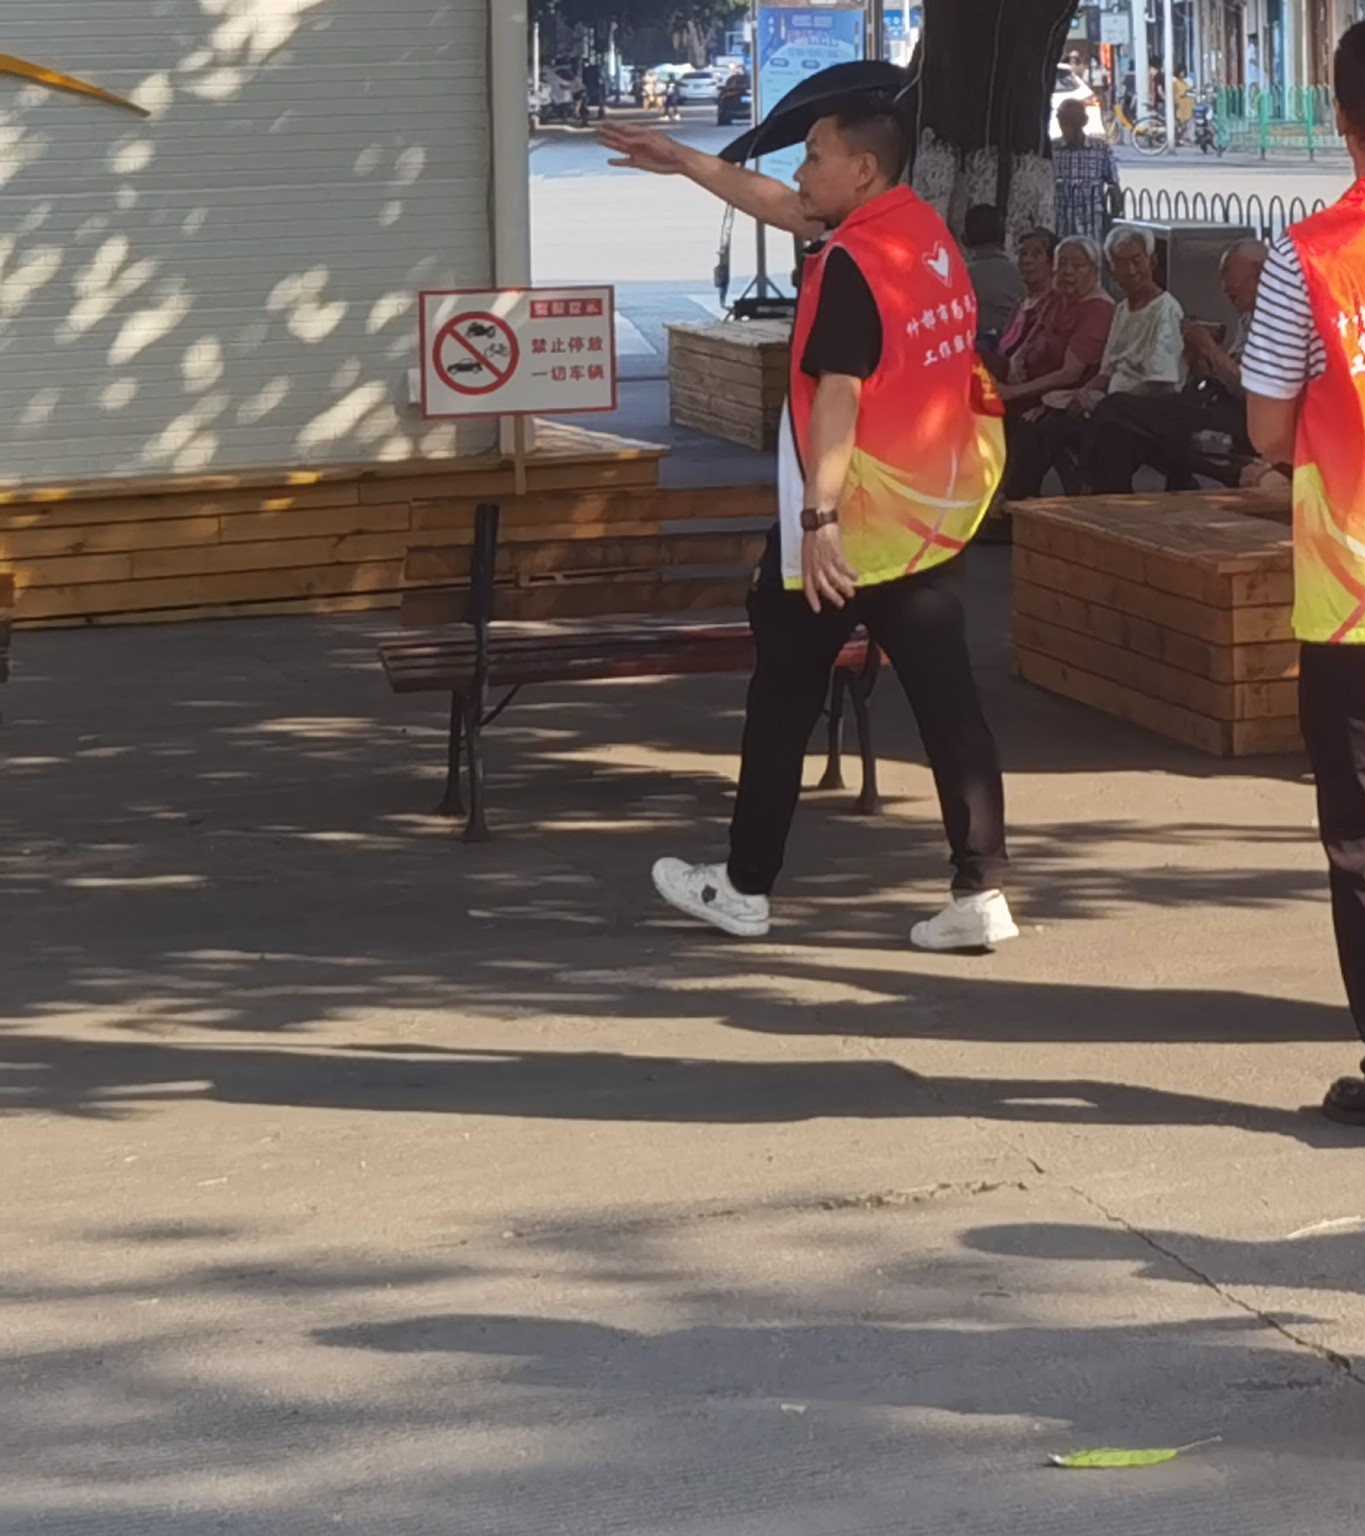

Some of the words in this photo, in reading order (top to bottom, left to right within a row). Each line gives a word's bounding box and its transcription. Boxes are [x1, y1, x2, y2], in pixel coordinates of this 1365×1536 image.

[531, 335, 603, 355] 禁止停放
[530, 364, 605, 382] 一切车辆
